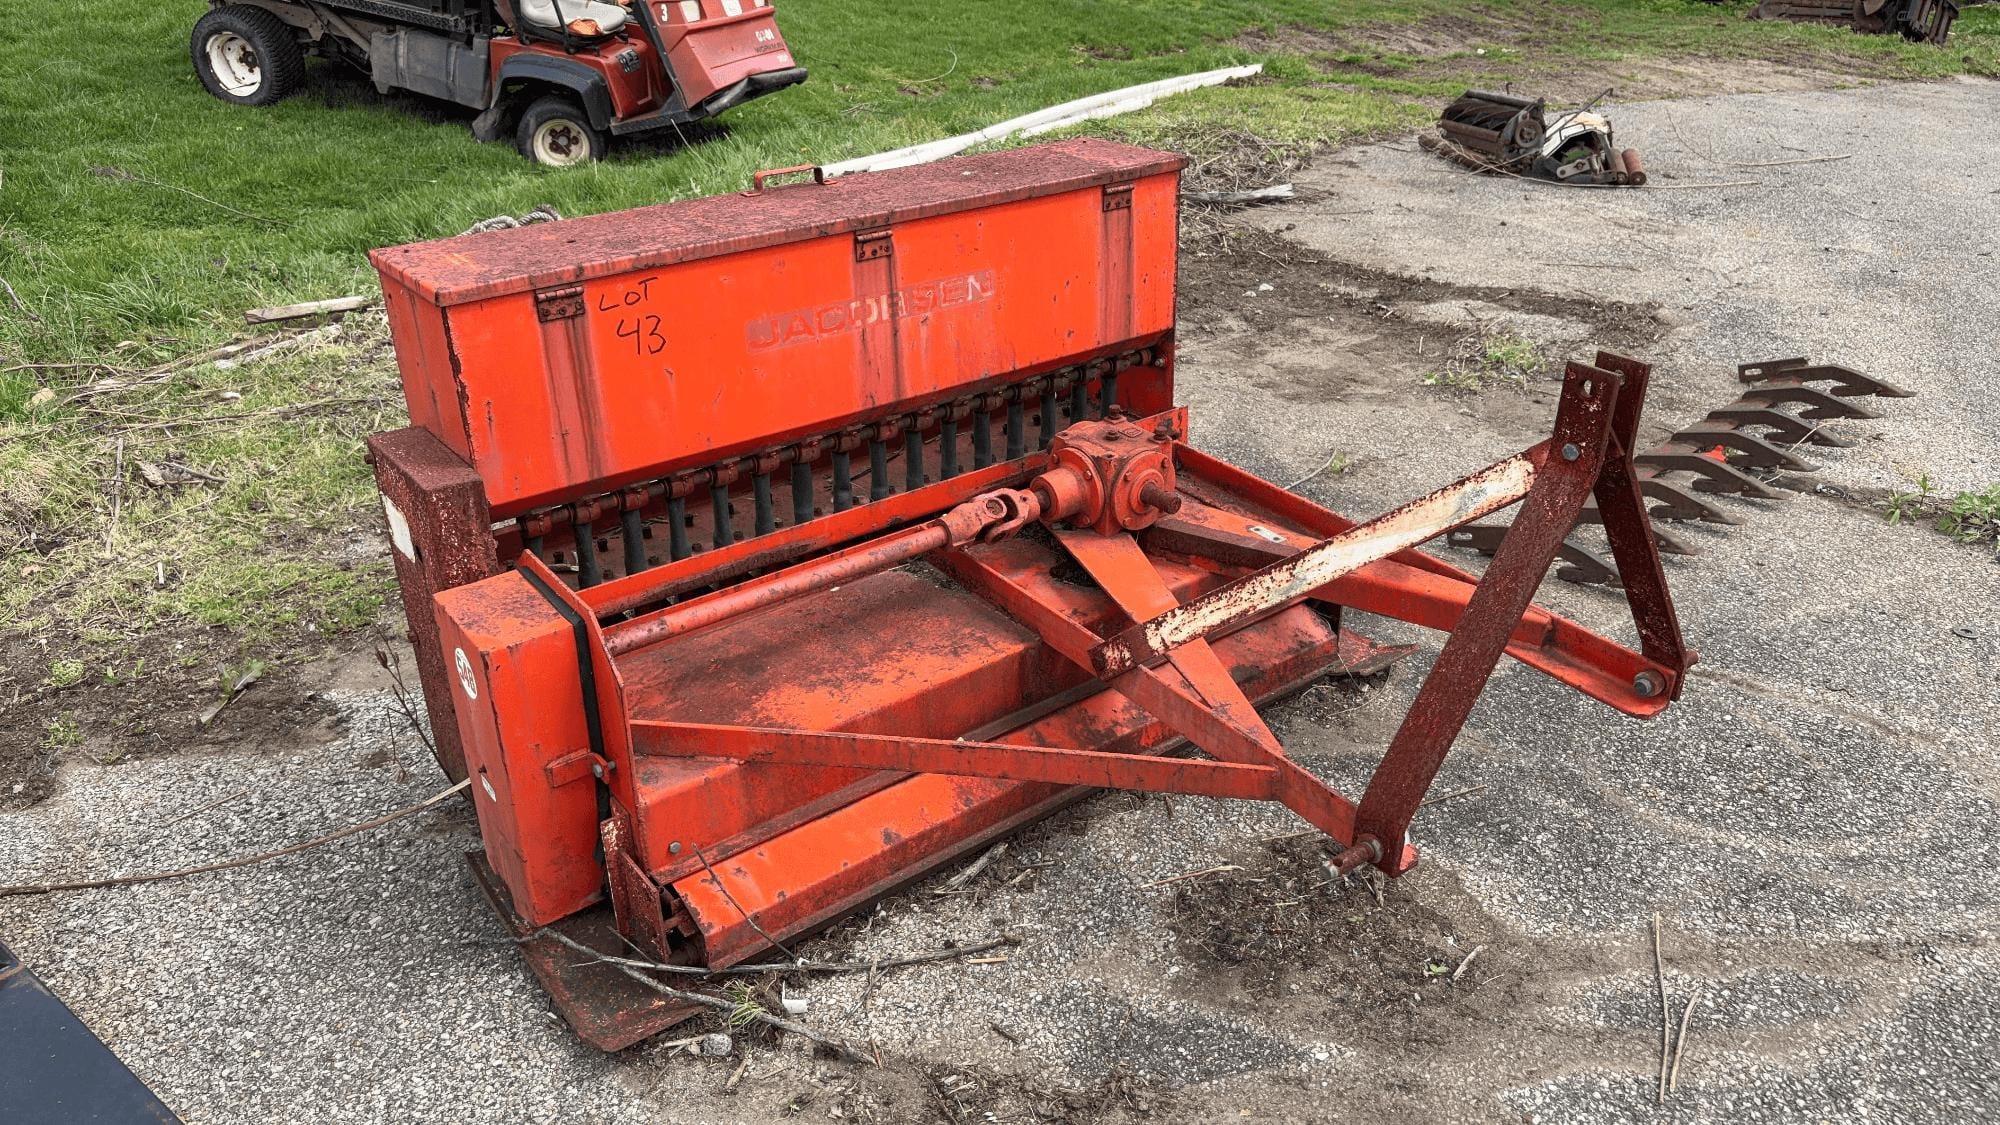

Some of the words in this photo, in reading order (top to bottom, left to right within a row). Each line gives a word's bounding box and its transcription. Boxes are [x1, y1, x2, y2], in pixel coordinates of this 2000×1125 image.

[660, 3, 668, 22] 3
[599, 276, 659, 311] LOT
[617, 315, 667, 355] 43
